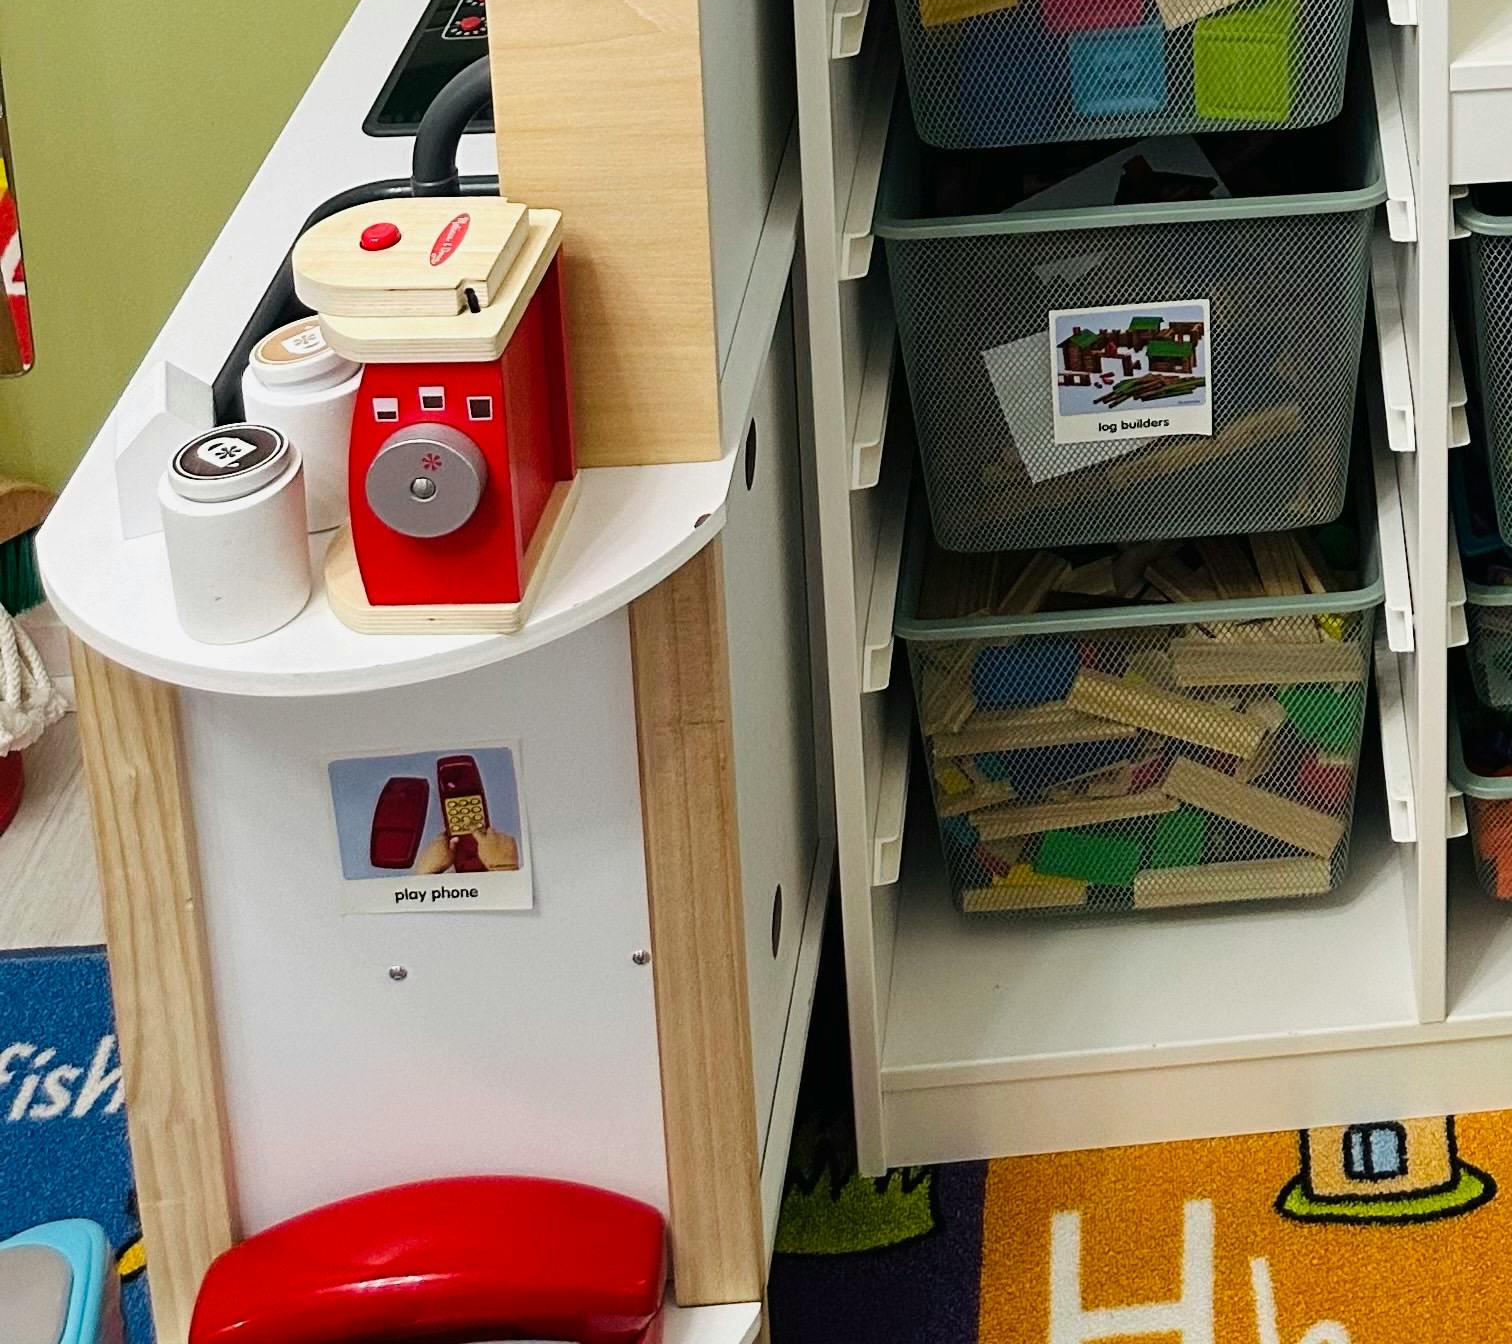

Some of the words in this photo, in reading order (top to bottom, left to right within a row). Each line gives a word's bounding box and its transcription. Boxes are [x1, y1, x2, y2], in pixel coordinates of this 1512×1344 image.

[1098, 423, 1117, 433] log
[1121, 418, 1170, 430] builders
[395, 888, 427, 903] play
[431, 886, 479, 902] phone
